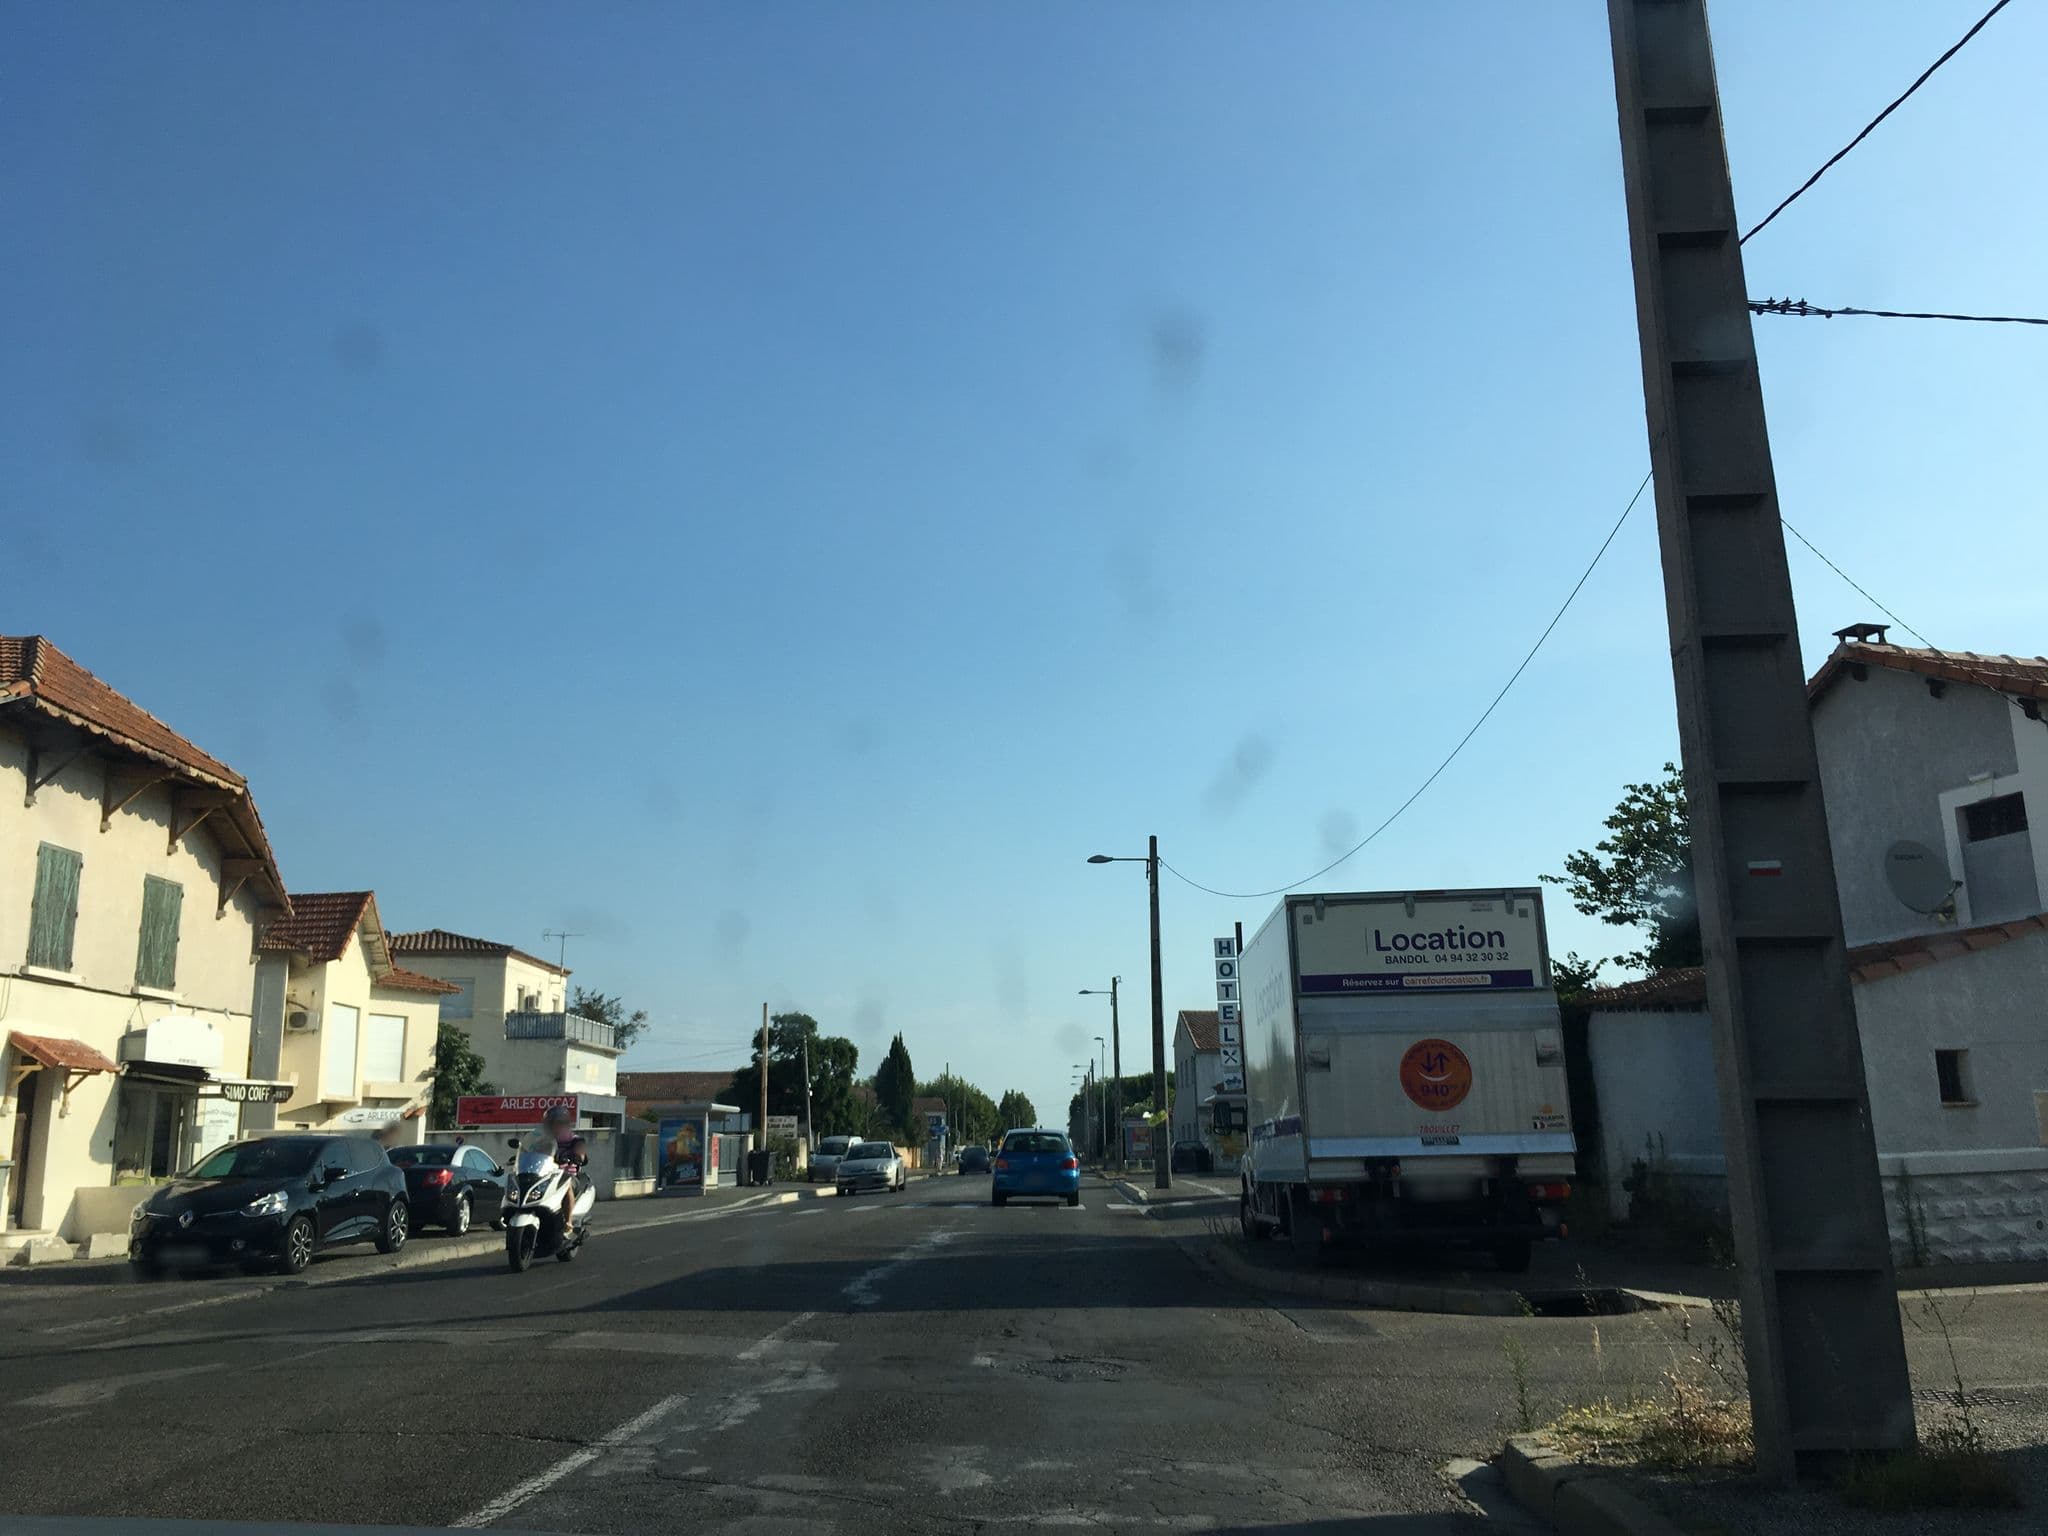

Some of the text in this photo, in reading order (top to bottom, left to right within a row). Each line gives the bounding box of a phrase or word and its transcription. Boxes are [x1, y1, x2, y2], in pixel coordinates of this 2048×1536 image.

[1374, 925, 1506, 952] Location
[1384, 952, 1509, 965] BANDOL 04 94 32 30 32
[1342, 977, 1383, 987] Réservez
[1404, 975, 1489, 985] carrefourlocation.fr
[1218, 940, 1236, 1042] HOTEL
[224, 1085, 246, 1101] SIMO
[500, 1097, 576, 1109] ARLES OCCAZ
[367, 1112, 389, 1121] ARLES
